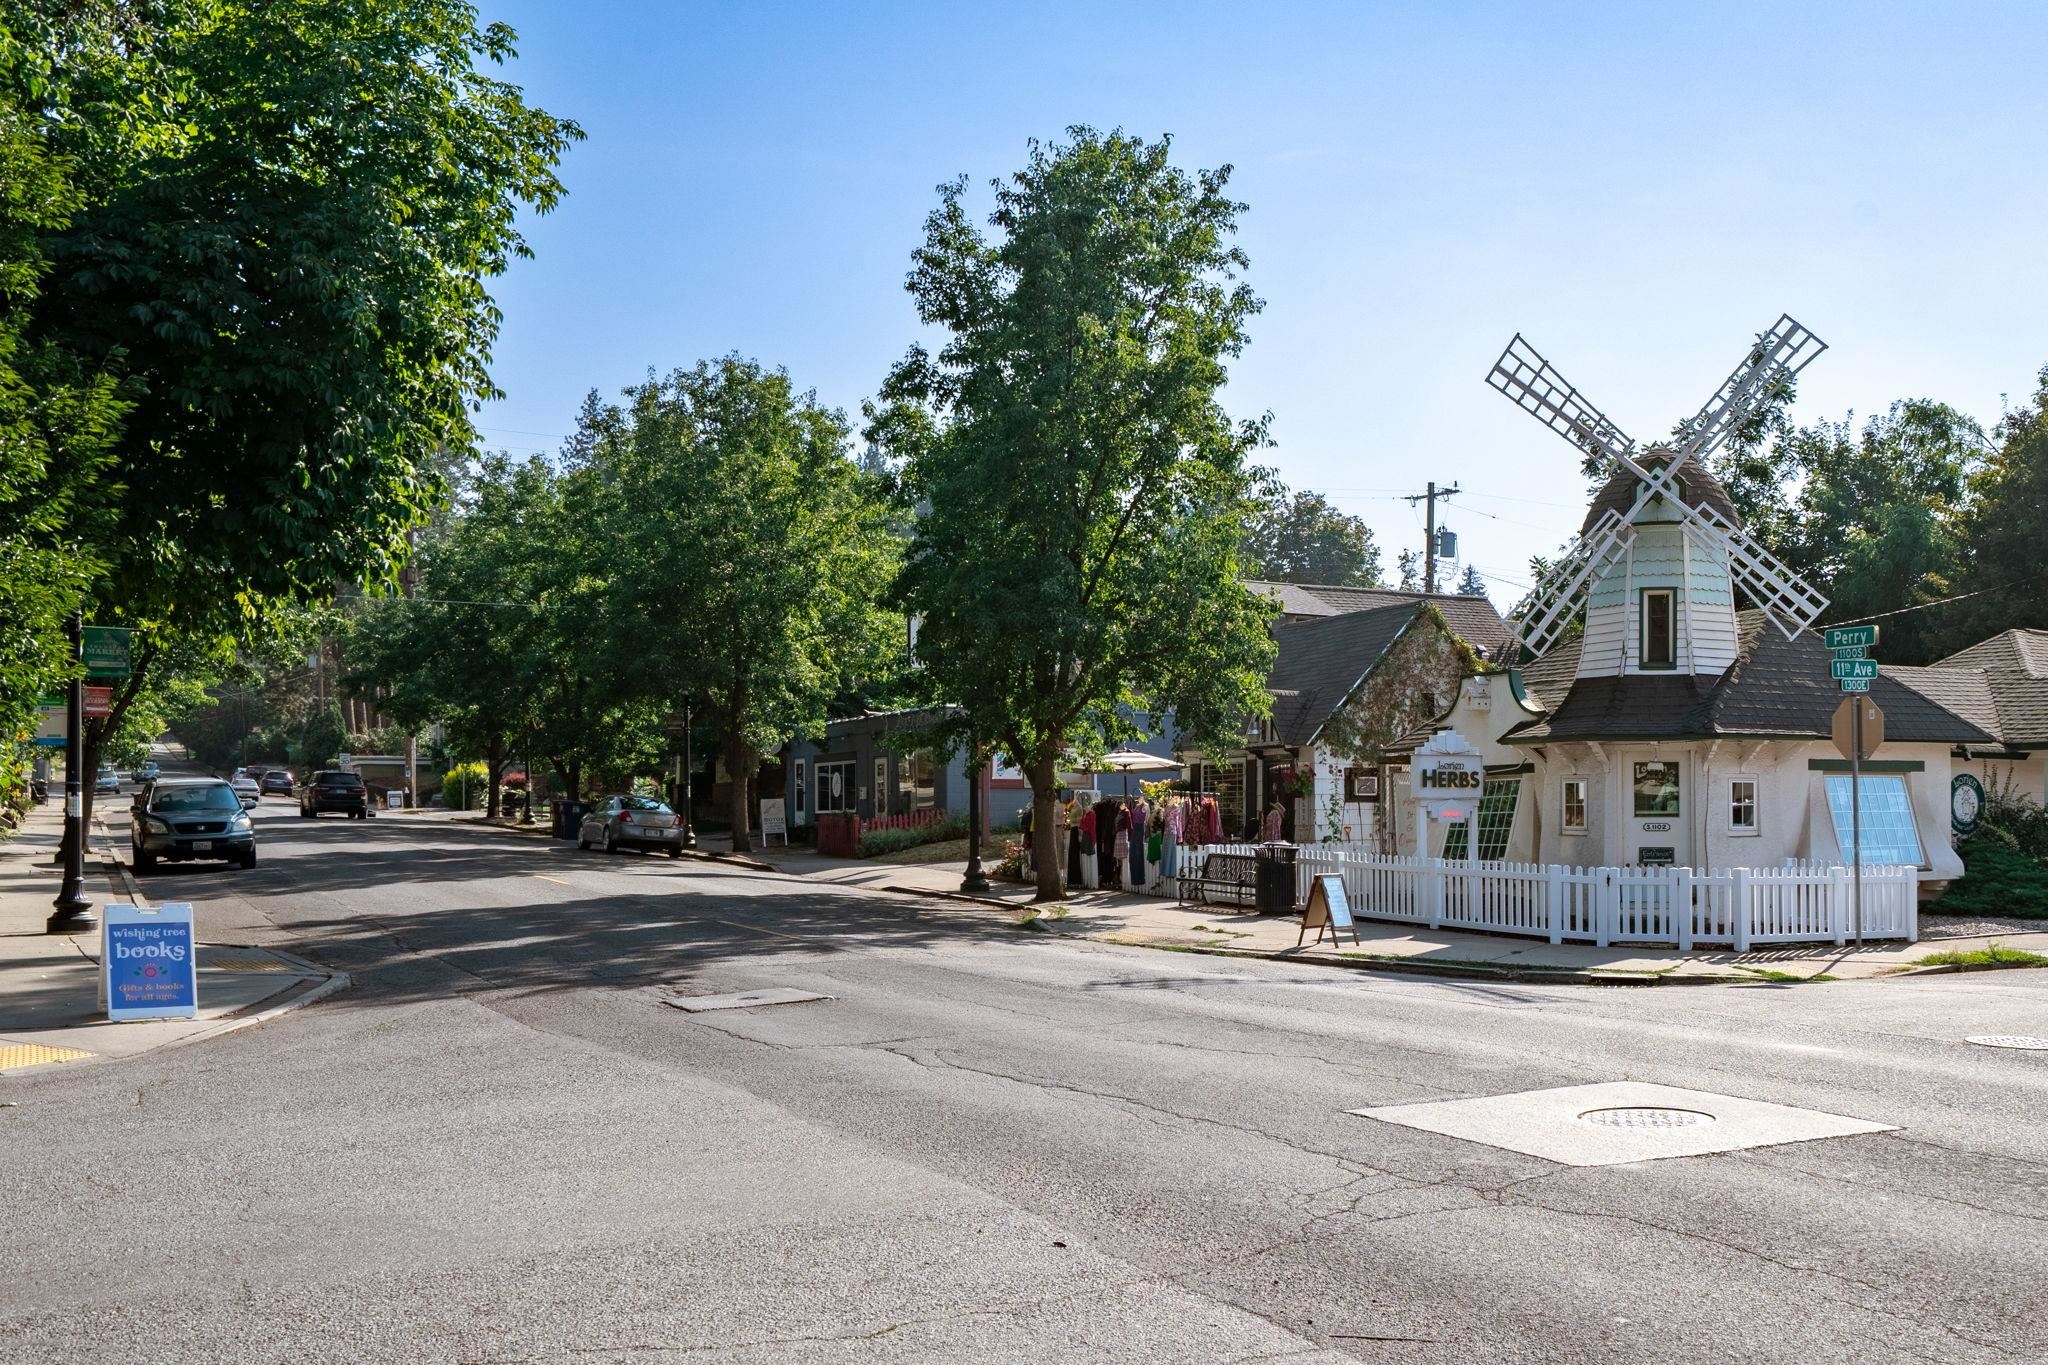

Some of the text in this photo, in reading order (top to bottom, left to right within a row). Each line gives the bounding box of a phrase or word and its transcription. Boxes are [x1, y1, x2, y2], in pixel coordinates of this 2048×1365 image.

[1834, 630, 1867, 645] Perry
[1839, 647, 1863, 658] 1100S
[1836, 662, 1873, 677] 11th Ave
[1844, 680, 1867, 690] 1300E
[1422, 768, 1480, 788] HERBS
[113, 928, 186, 941] wishing tree
[115, 941, 186, 961] books
[145, 983, 154, 991] &
[156, 982, 185, 991] books
